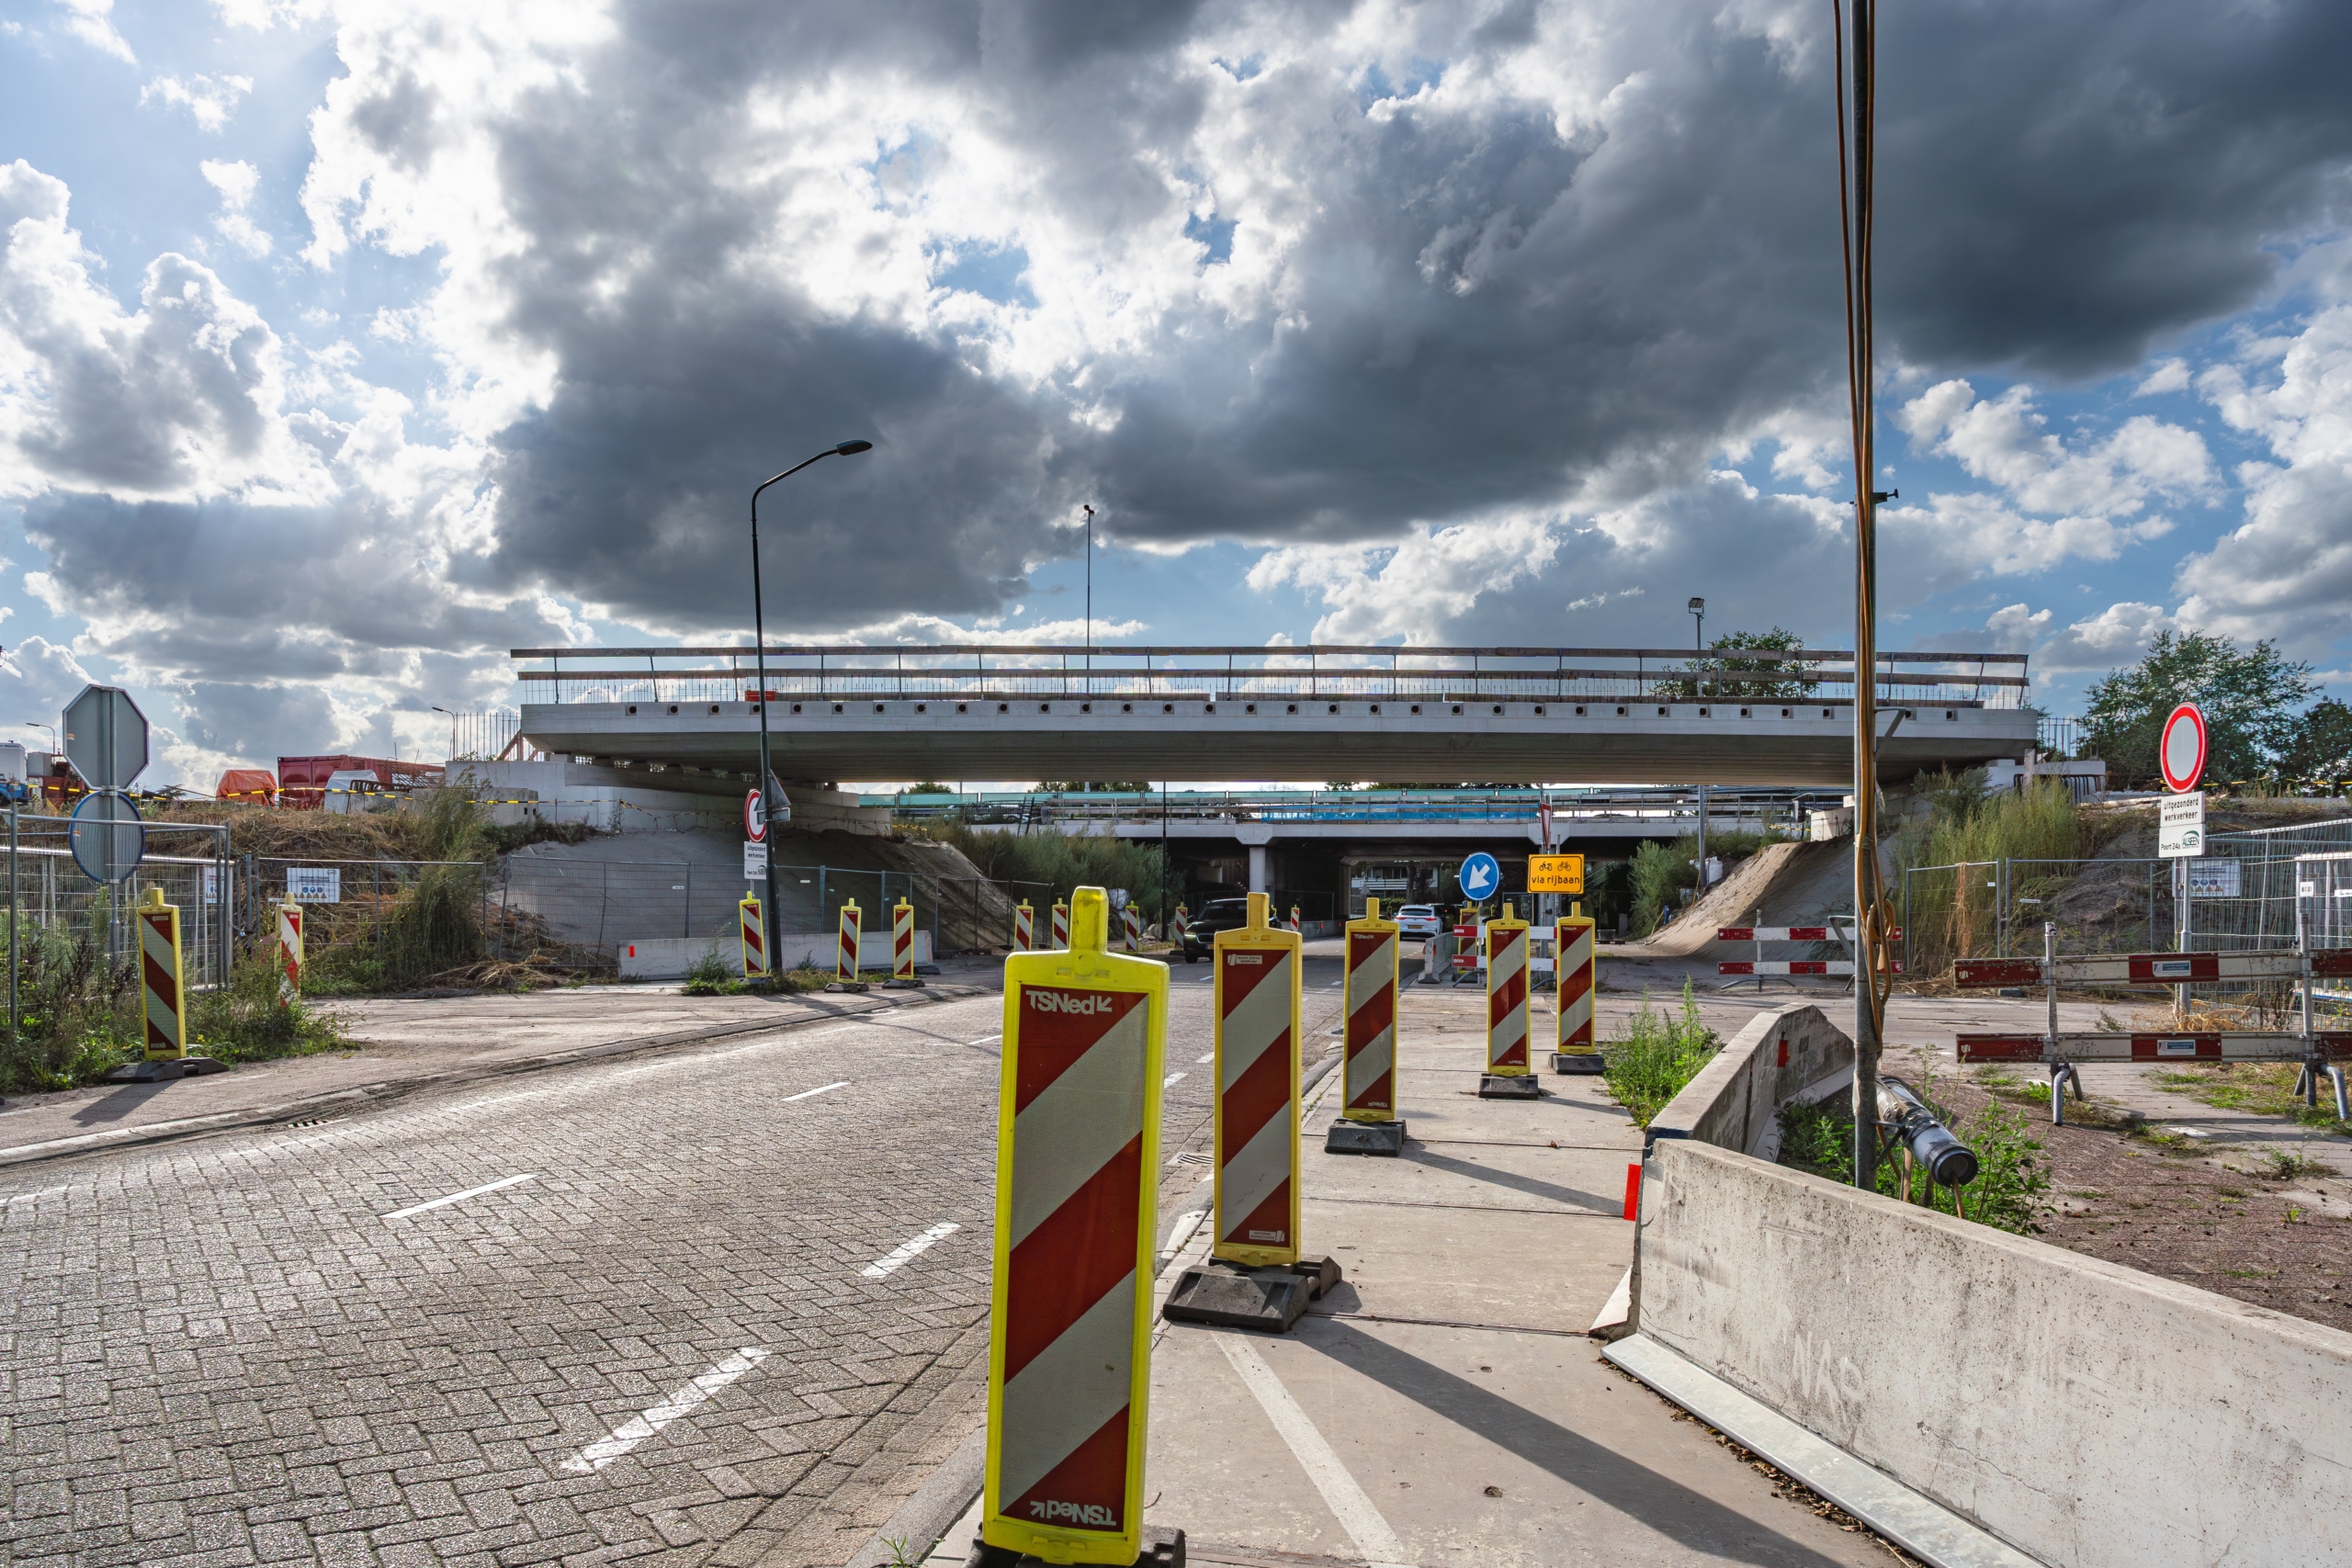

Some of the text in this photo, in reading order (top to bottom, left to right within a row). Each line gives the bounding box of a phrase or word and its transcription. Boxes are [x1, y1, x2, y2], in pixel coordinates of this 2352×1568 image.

[2164, 796, 2199, 811] uitgezonderd
[2165, 811, 2198, 822] werkverkeer
[1532, 875, 1580, 886] via rijbaan
[1025, 989, 1094, 1015] TSNed
[1046, 1499, 1116, 1526] TSNed
